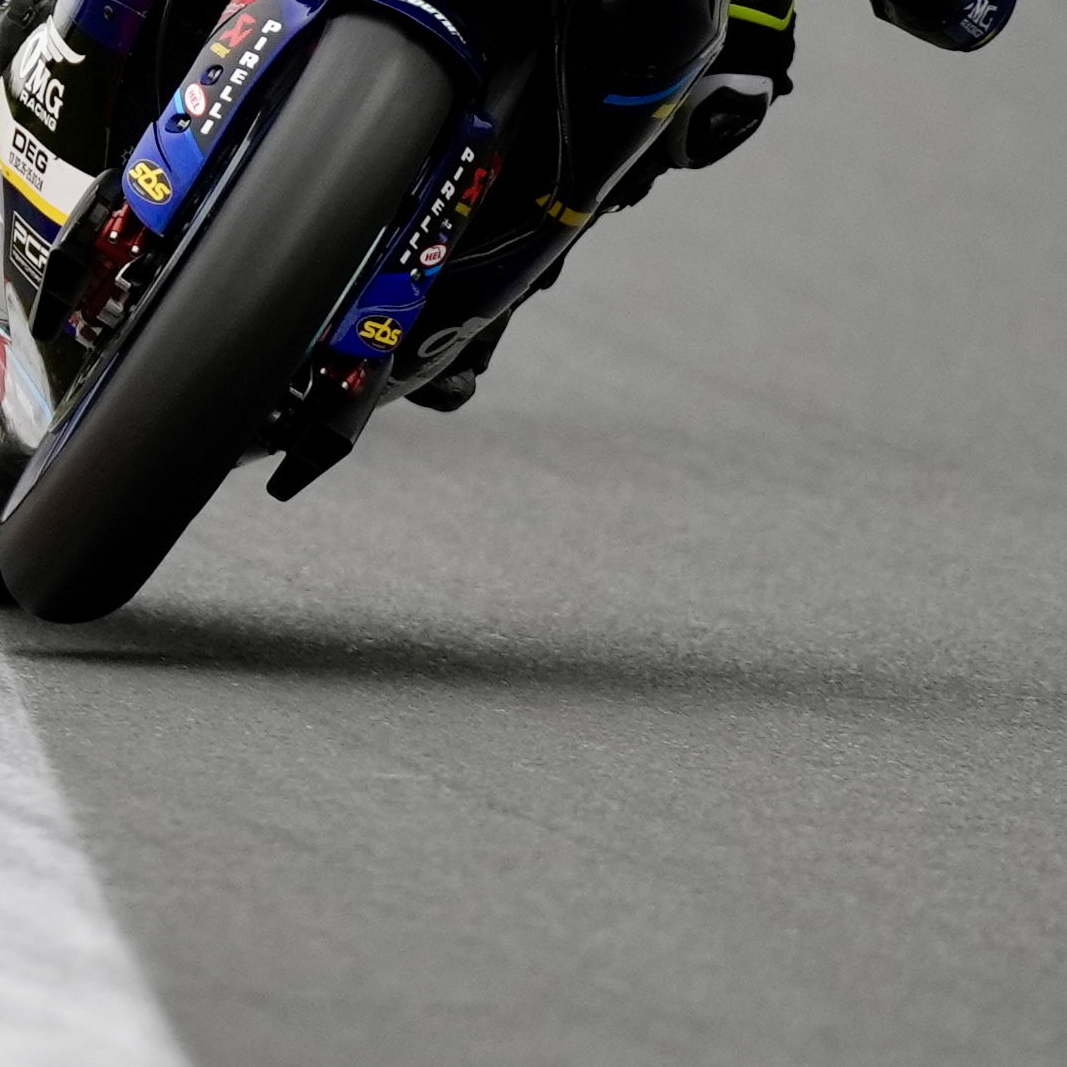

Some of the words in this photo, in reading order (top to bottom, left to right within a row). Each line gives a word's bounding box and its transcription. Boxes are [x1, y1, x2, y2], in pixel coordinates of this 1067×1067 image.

[20, 90, 57, 132] RACING
[200, 19, 283, 135] PIRELLI
[12, 128, 49, 174] DEG
[400, 146, 475, 265] PIRELLI
